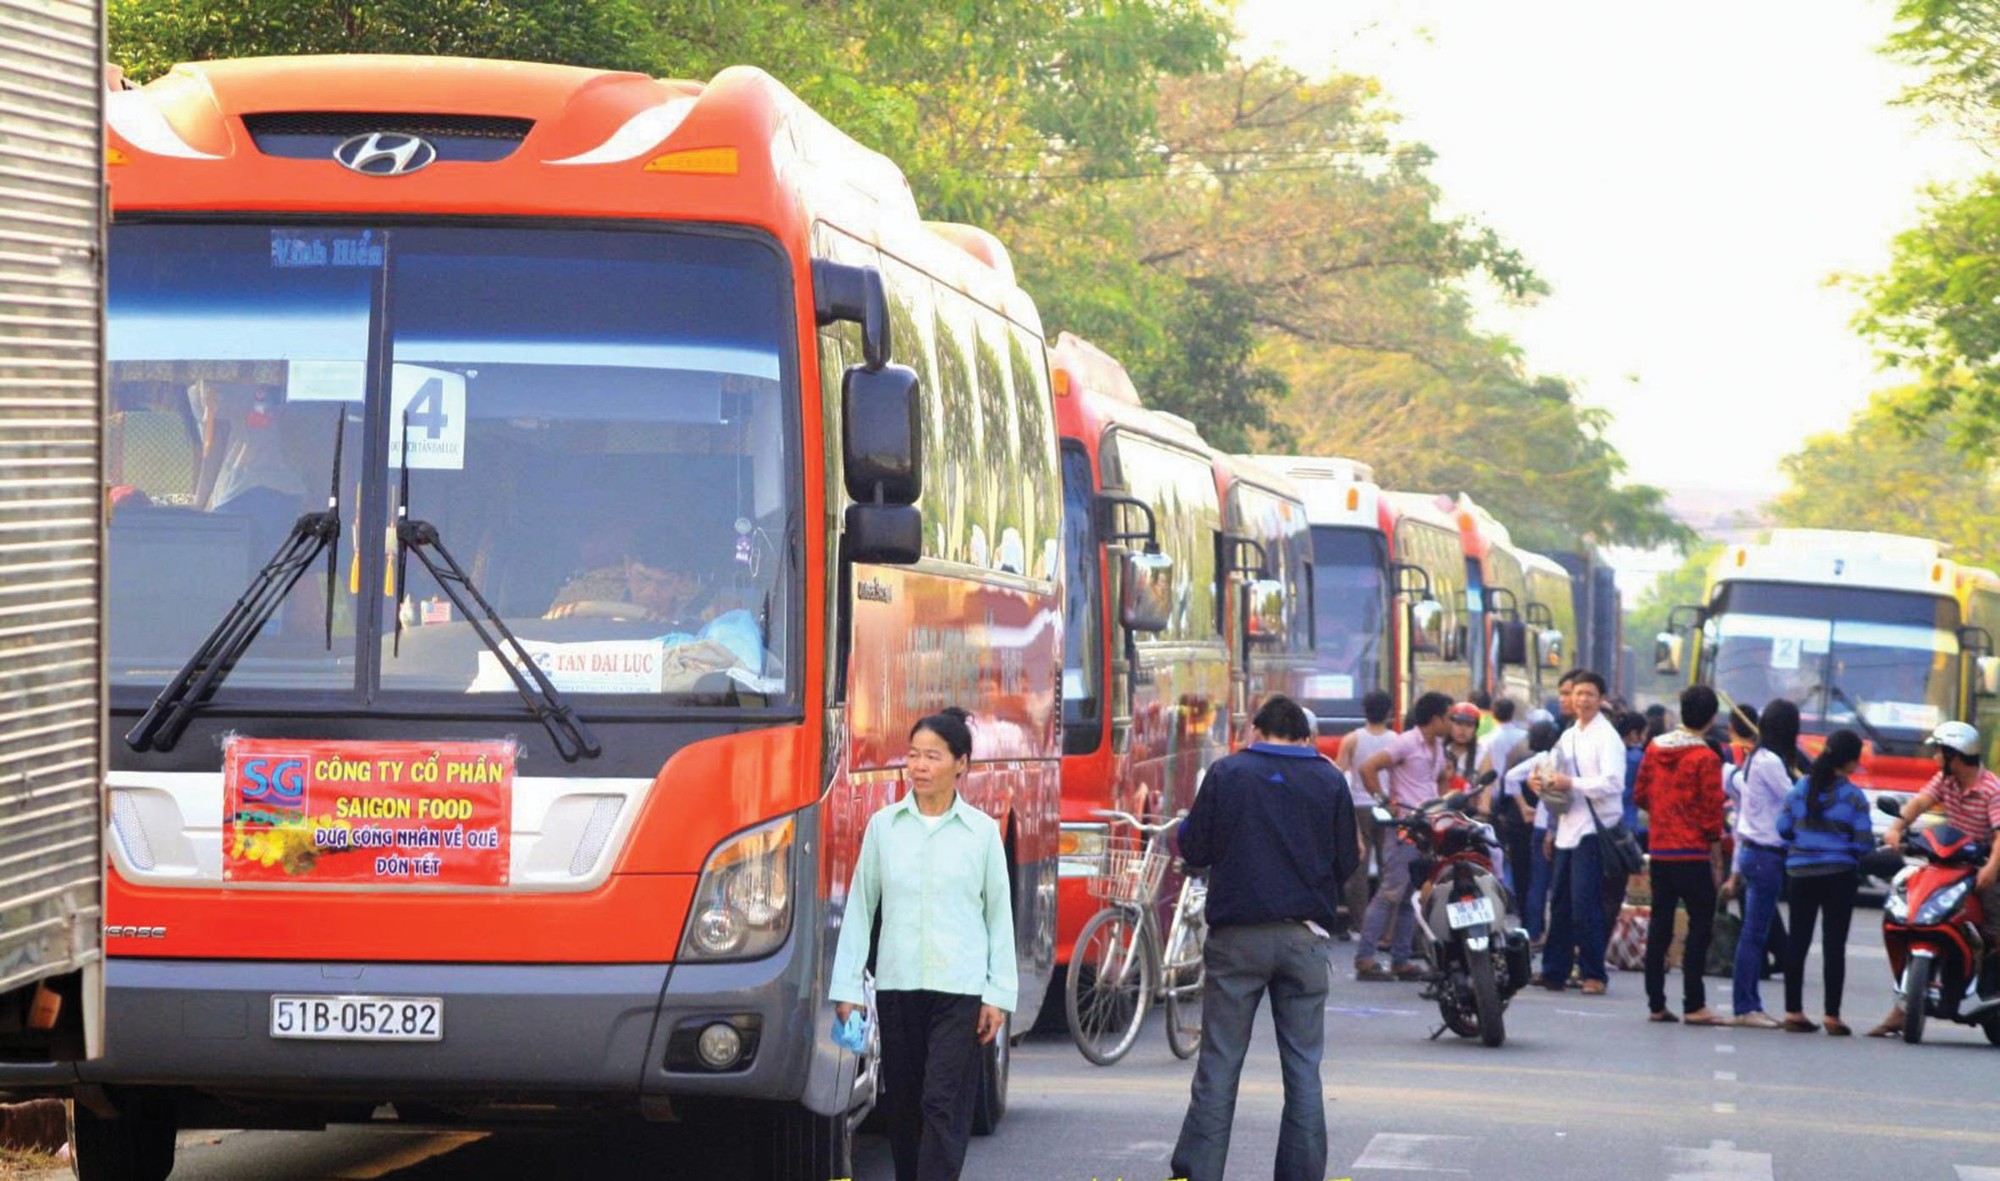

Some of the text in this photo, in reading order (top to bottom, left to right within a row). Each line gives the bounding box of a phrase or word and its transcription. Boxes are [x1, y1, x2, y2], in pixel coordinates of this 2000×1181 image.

[403, 377, 448, 439] 4
[242, 759, 304, 798] SG
[314, 751, 503, 783] CÔNG TY CỔ PHẦN
[335, 797, 473, 819] SAIGON FOOD
[352, 824, 392, 847] CÔNG
[467, 828, 498, 847] QUÊ
[375, 852, 441, 875] ĐÓN TẾT
[277, 1001, 436, 1035] 51B-052.82
